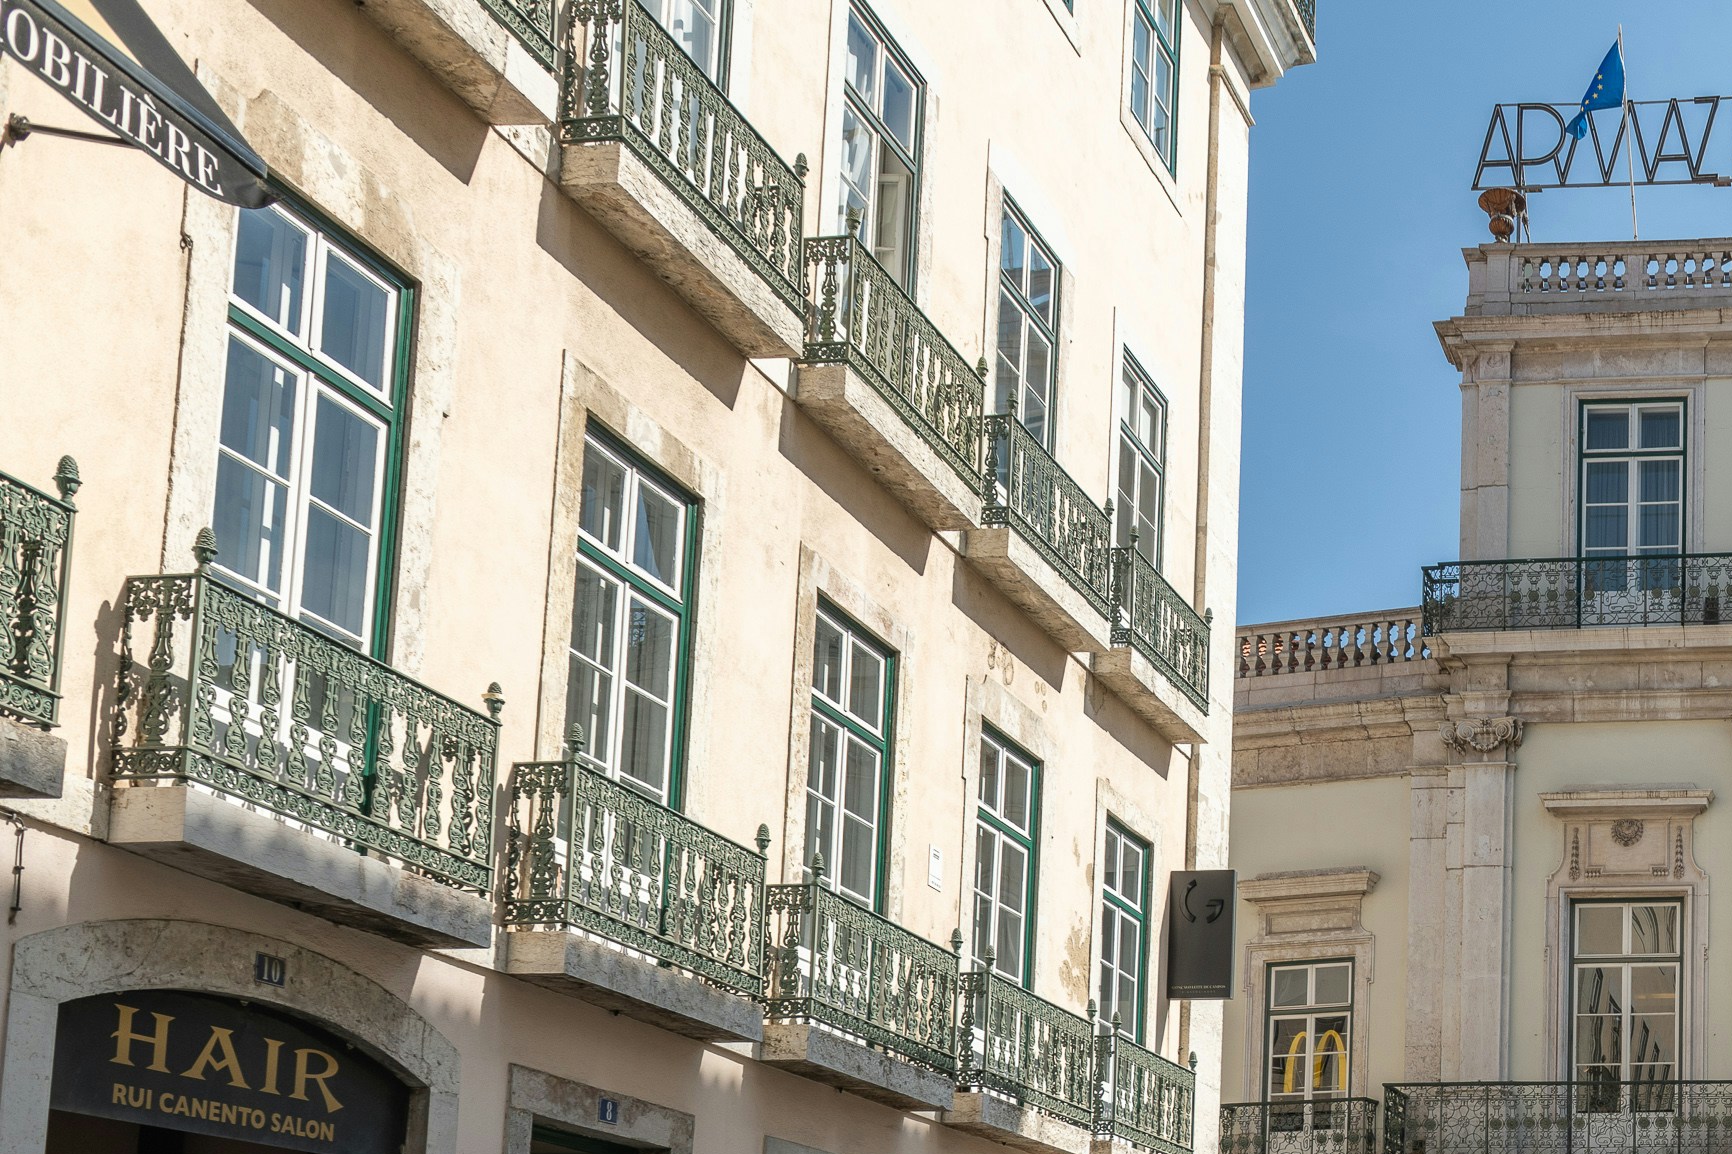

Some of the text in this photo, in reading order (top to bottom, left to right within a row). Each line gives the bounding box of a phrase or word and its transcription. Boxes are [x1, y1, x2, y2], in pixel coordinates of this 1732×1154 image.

[0, 8, 224, 196] OBILIÈRE
[262, 956, 281, 983] 10
[109, 1003, 344, 1113] HAIR
[112, 1083, 335, 1142] RUI CANENTO SALON
[605, 1101, 613, 1121] 8
